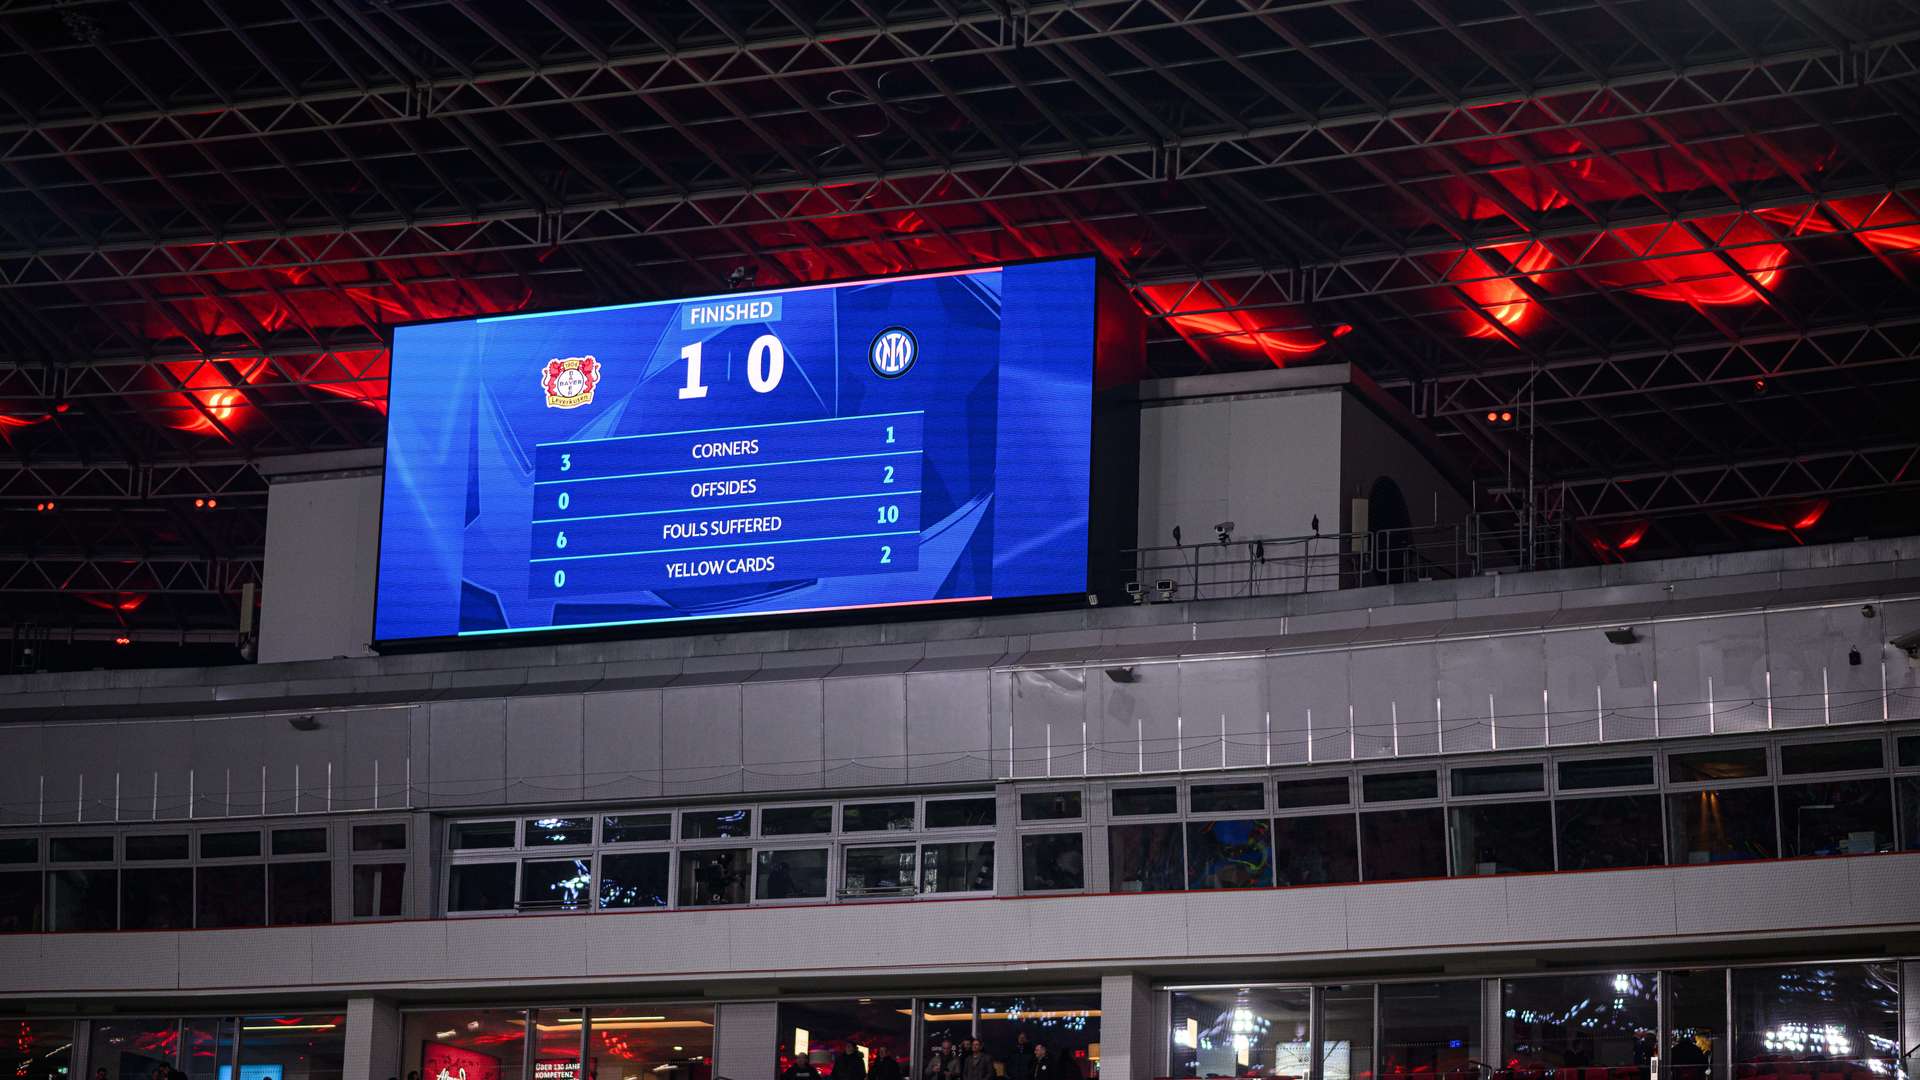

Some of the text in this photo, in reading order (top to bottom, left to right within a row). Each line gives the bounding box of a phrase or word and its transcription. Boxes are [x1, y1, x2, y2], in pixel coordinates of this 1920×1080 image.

[691, 301, 773, 325] FINISHED
[679, 334, 784, 400] 1 0
[560, 426, 896, 471] 3 CORNERS 1
[558, 465, 894, 510] 0 OFFSIDES 2
[556, 505, 899, 549] 6 FOULS SUFFERED 10
[554, 545, 891, 588] 0 YELLOW CARDS 2
[535, 1063, 553, 1071] ÜBER
[535, 1071, 574, 1079] KOMPETENZ
